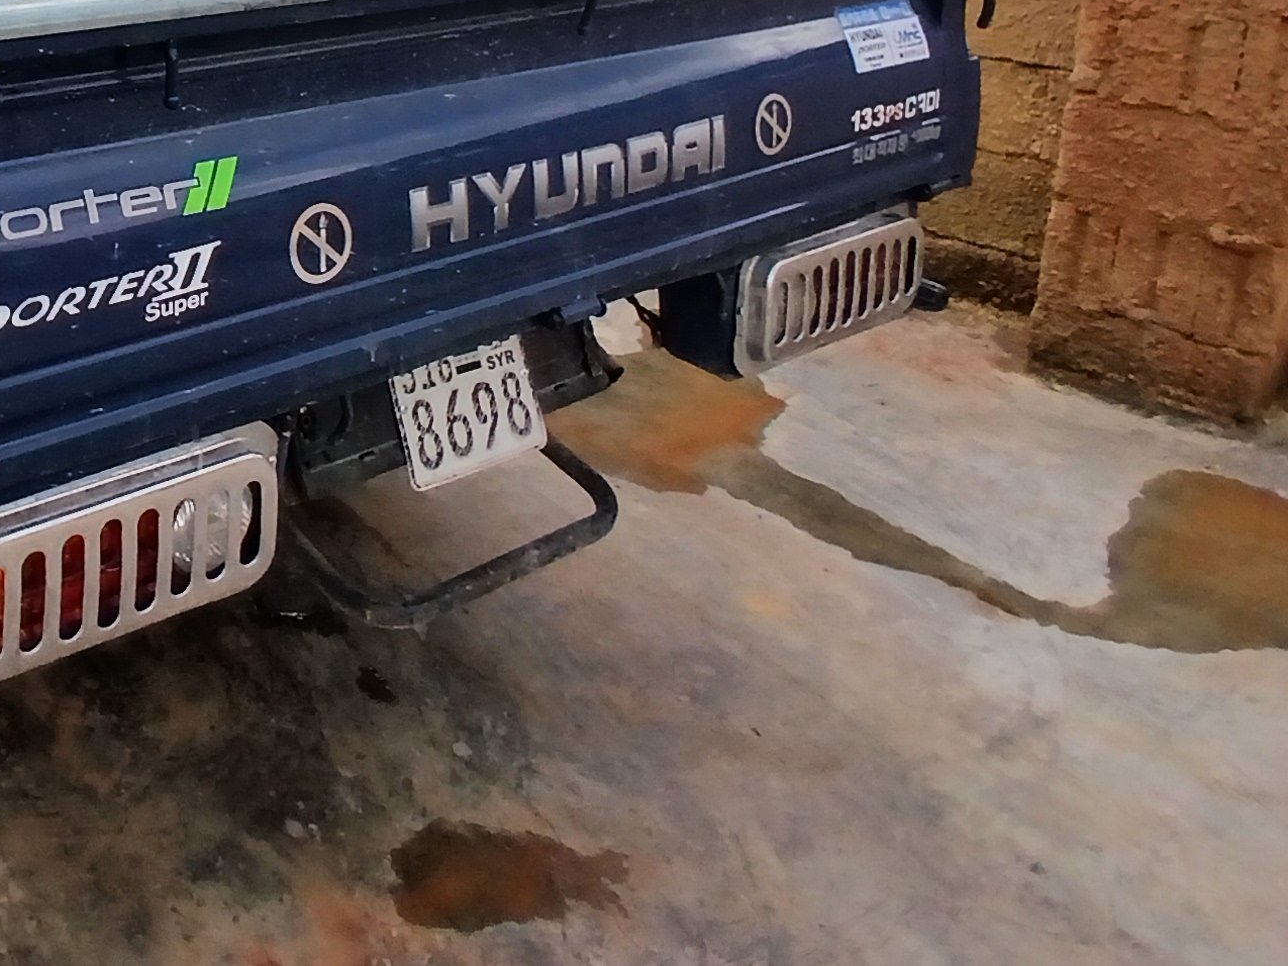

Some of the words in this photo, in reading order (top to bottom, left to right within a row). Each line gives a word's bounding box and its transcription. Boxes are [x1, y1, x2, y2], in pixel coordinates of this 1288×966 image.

[409, 115, 725, 252] HYUNDAI
[144, 288, 210, 323] Super
[486, 349, 516, 371] SYR
[412, 371, 533, 471] 8698
